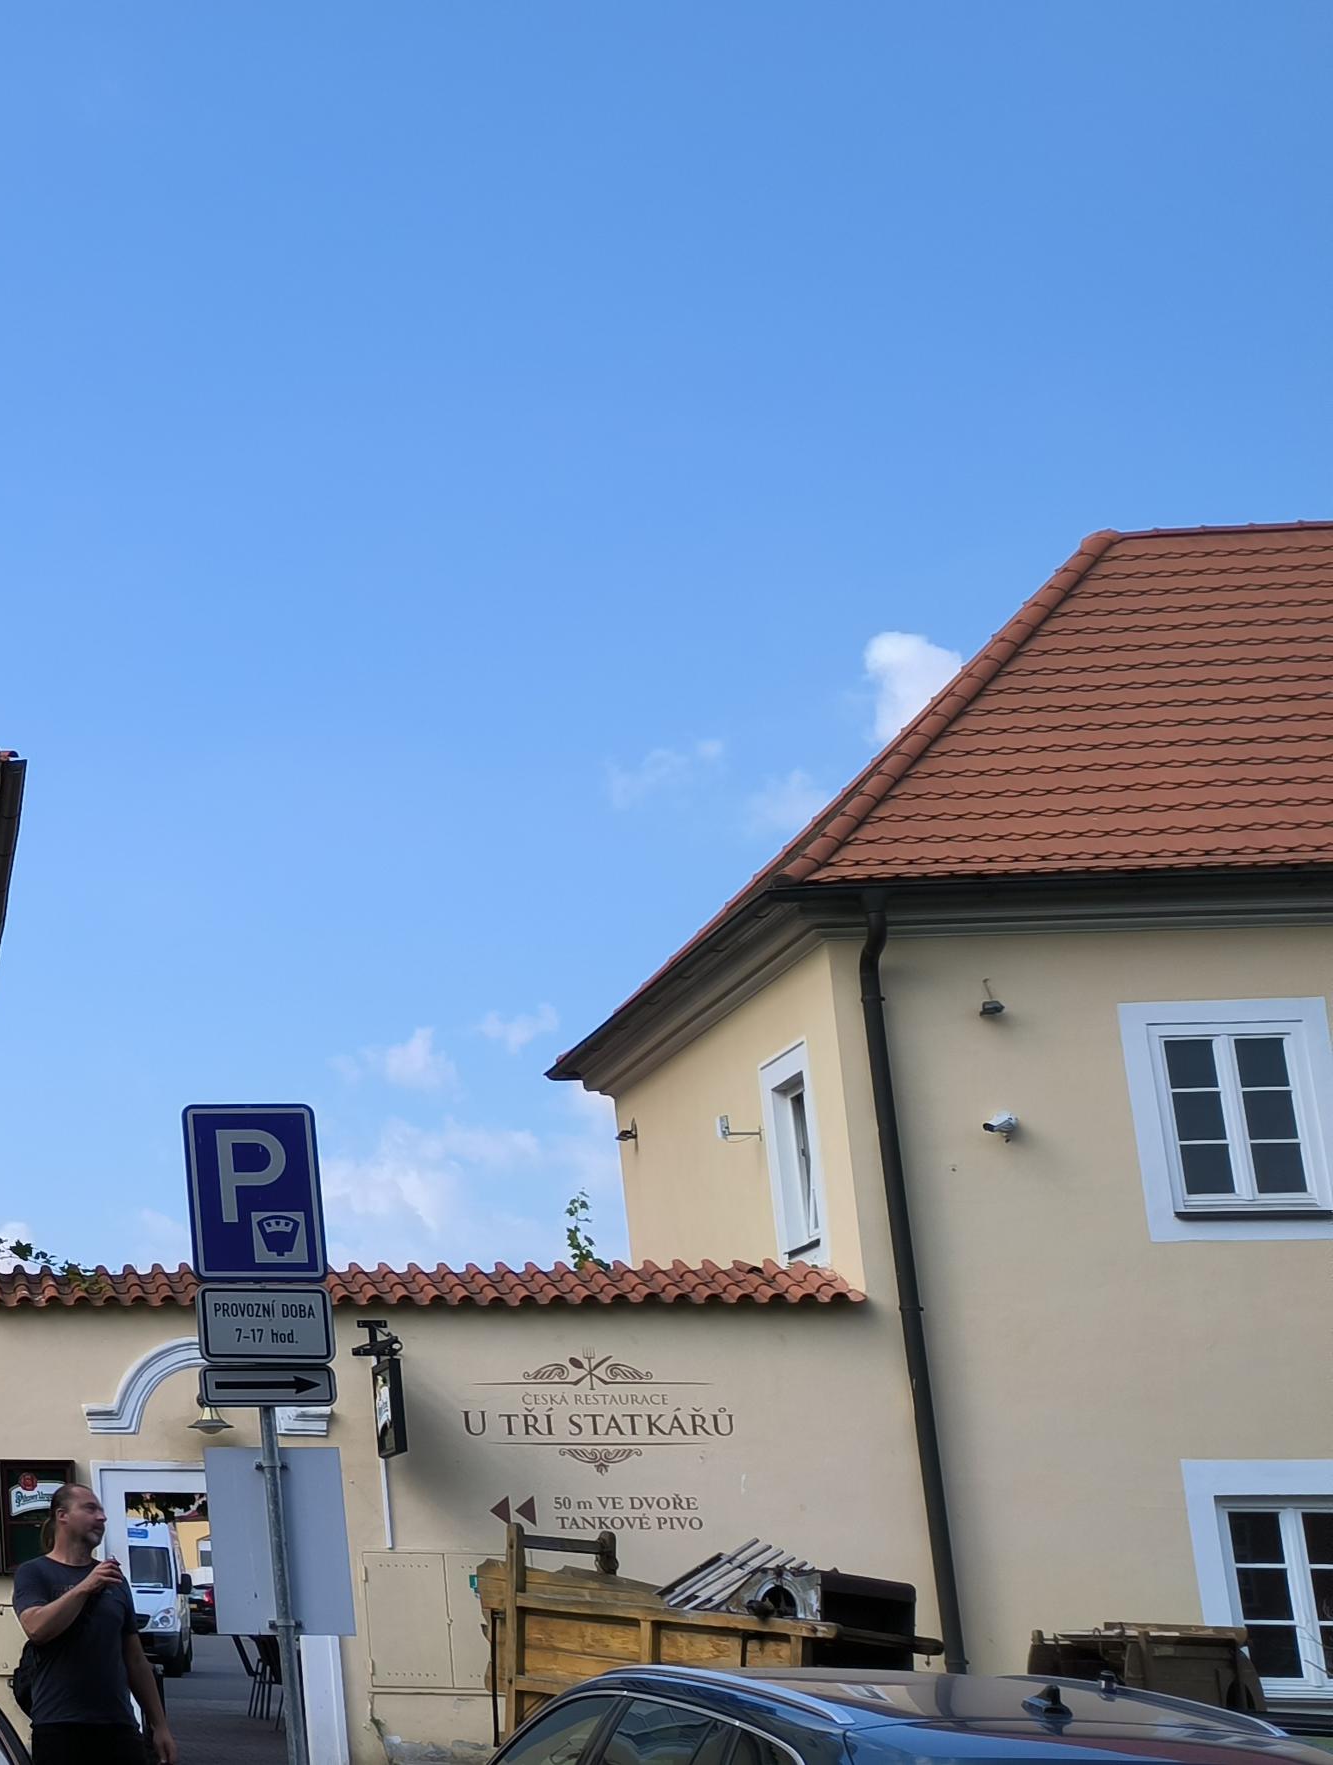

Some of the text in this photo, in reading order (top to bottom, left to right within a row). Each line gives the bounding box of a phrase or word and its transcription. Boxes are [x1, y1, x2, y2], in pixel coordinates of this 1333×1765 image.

[216, 1129, 286, 1223] P
[213, 1299, 316, 1321] PROVOZNÍ DOBA
[271, 1328, 299, 1345] hod.
[521, 1391, 669, 1406] ČESKÁ RESTAURACE
[462, 1407, 735, 1437] U TŘÍ STATKÁŘŮ
[554, 1493, 698, 1511] 50 m VE DVOŘE
[556, 1513, 704, 1530] TANKOVÉ PIVO
